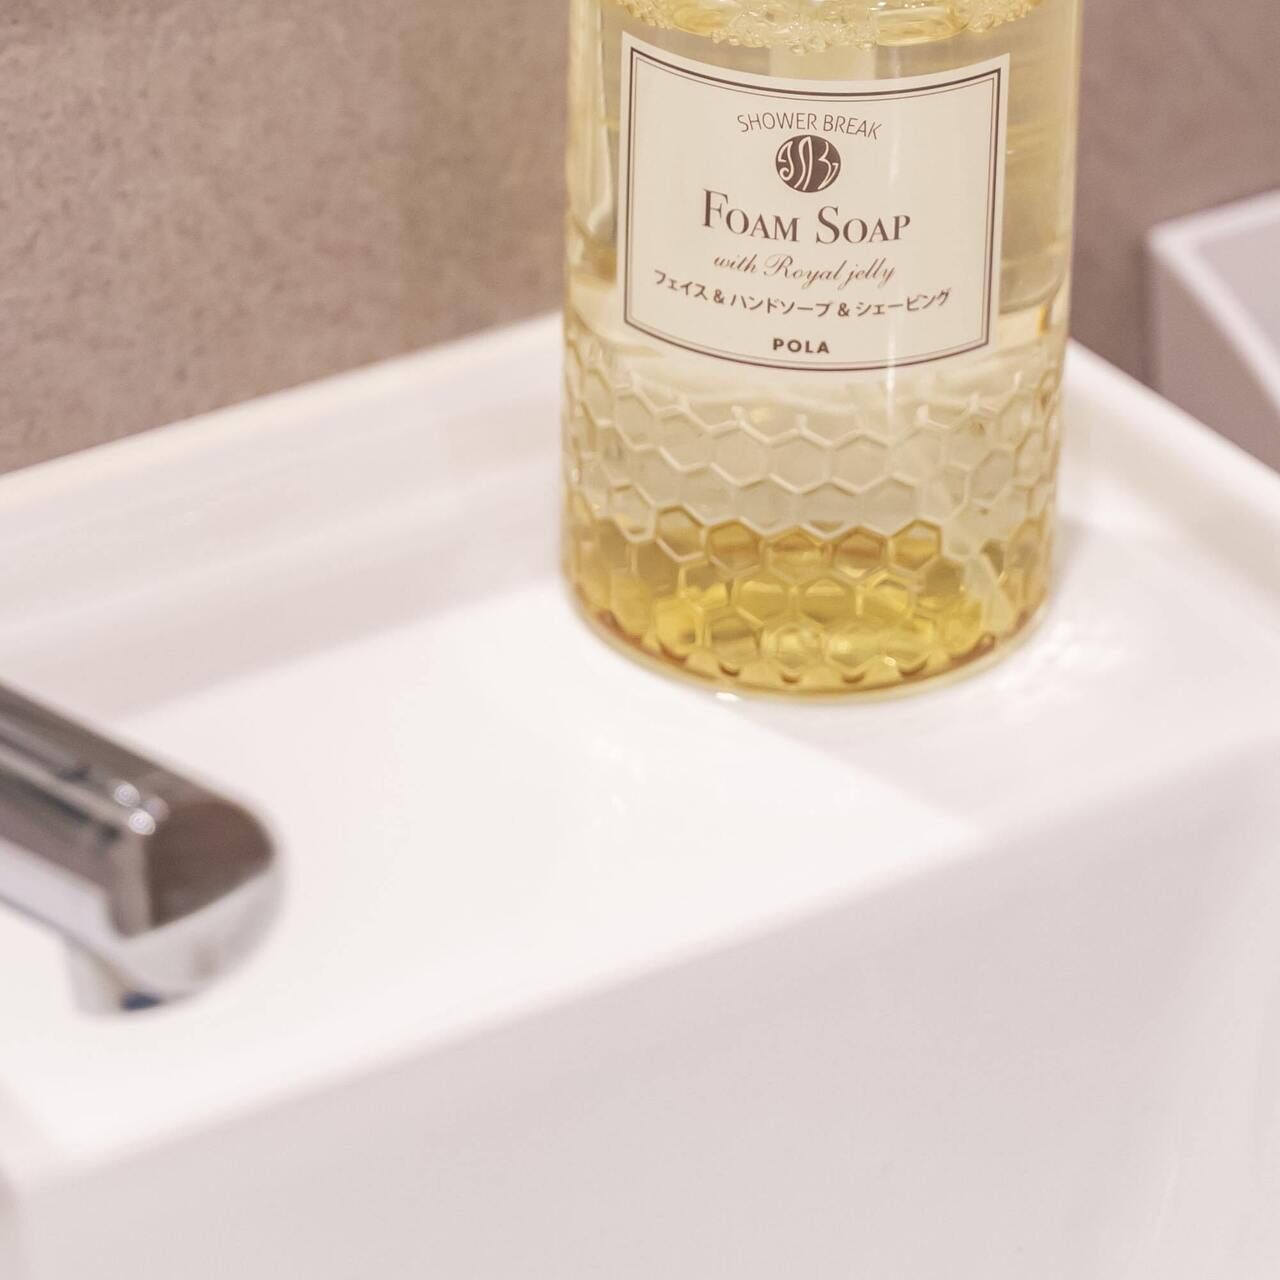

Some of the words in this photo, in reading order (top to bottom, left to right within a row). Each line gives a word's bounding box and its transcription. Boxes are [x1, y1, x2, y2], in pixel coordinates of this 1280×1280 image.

[737, 112, 818, 133] SHOWER
[823, 114, 882, 140] BREAK
[702, 189, 800, 242] FOAM
[816, 205, 910, 244] SOAP
[713, 254, 757, 273] with
[763, 253, 847, 290] Royal
[837, 257, 895, 290] jelly
[773, 338, 830, 354] POLA
